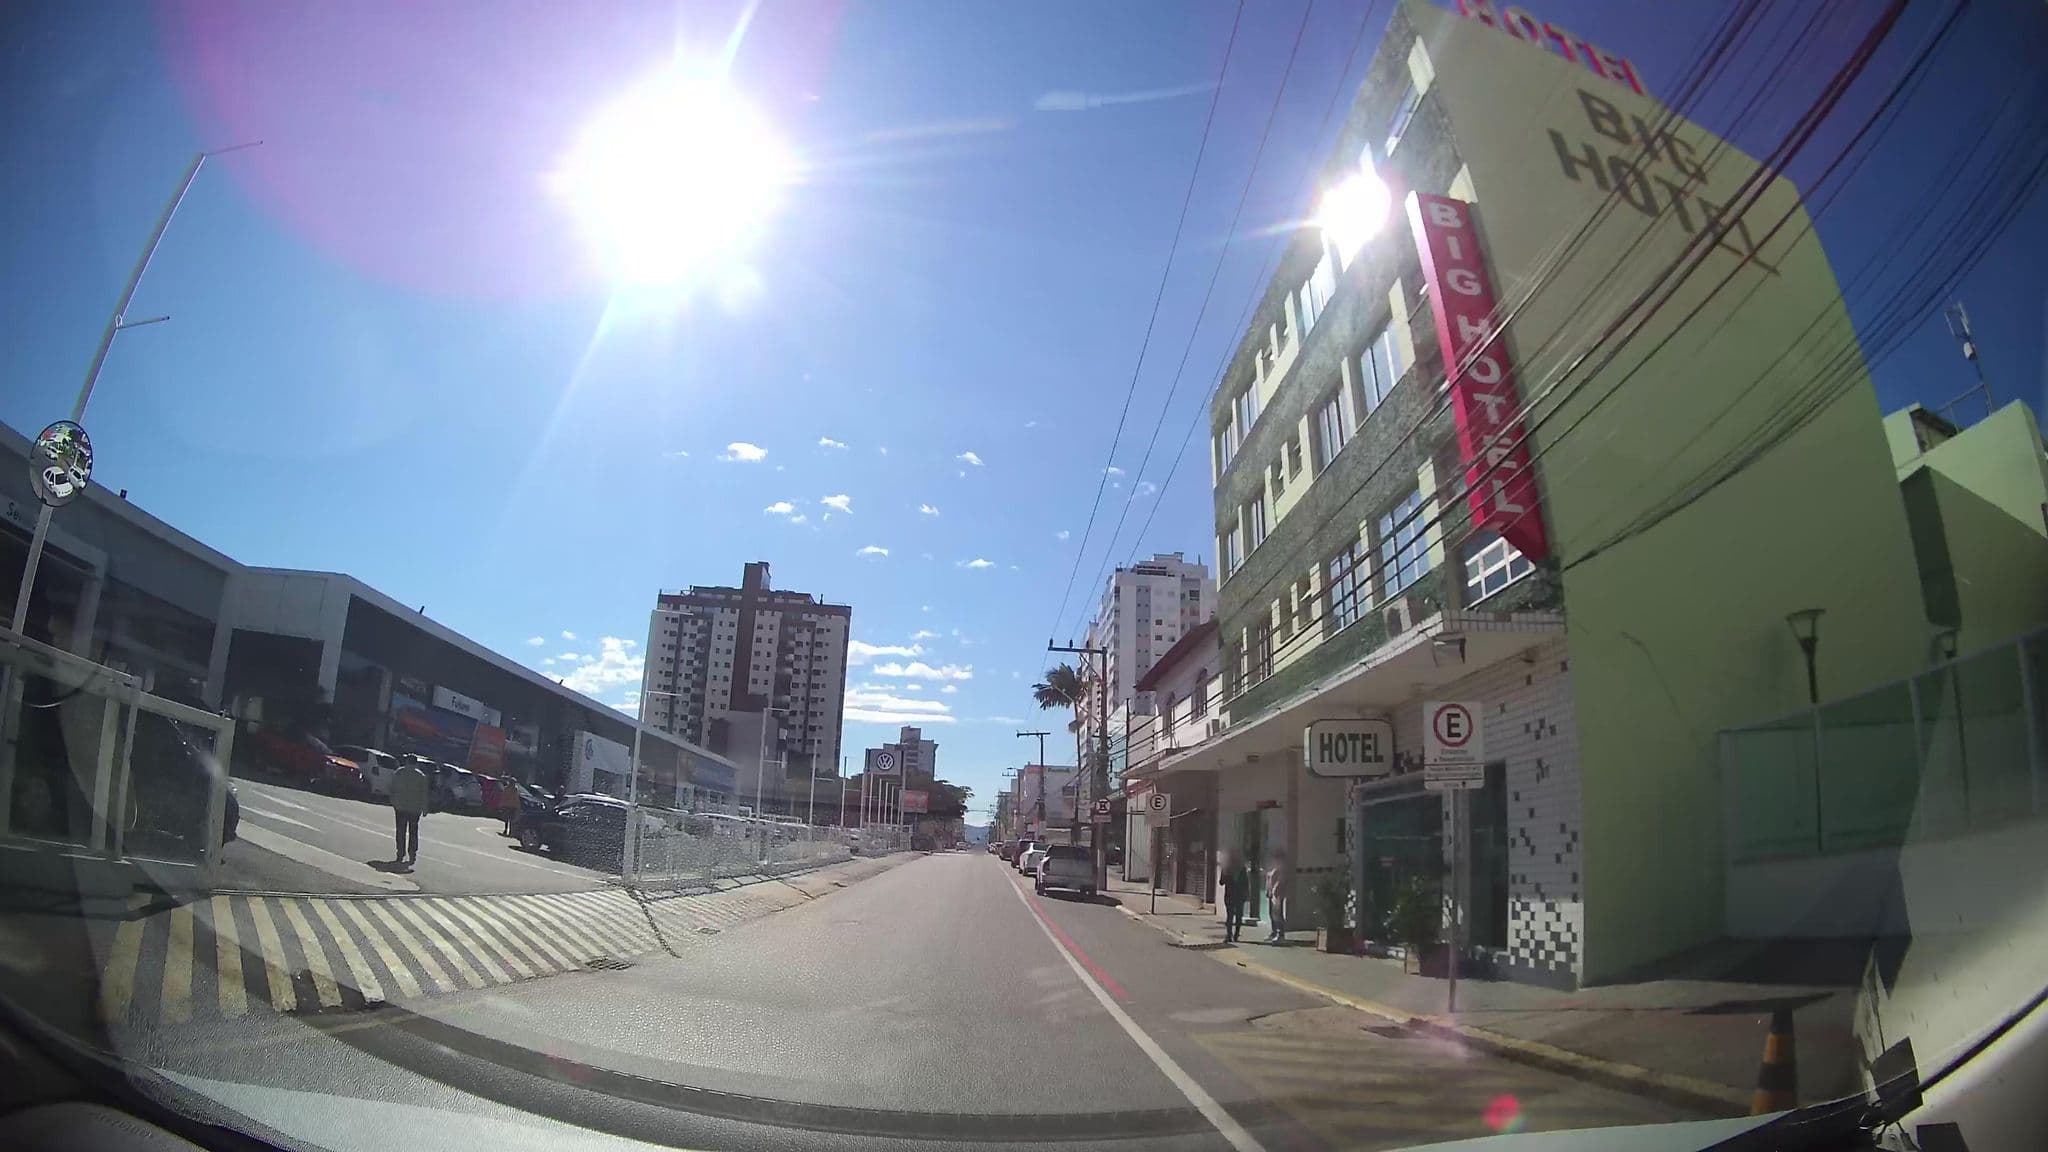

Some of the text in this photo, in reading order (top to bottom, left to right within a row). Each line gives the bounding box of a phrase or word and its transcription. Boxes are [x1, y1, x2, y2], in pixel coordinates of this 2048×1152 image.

[1428, 202, 1524, 513] BIG HOTEL
[1446, 712, 1462, 738] E
[1320, 732, 1384, 763] HOTEL
